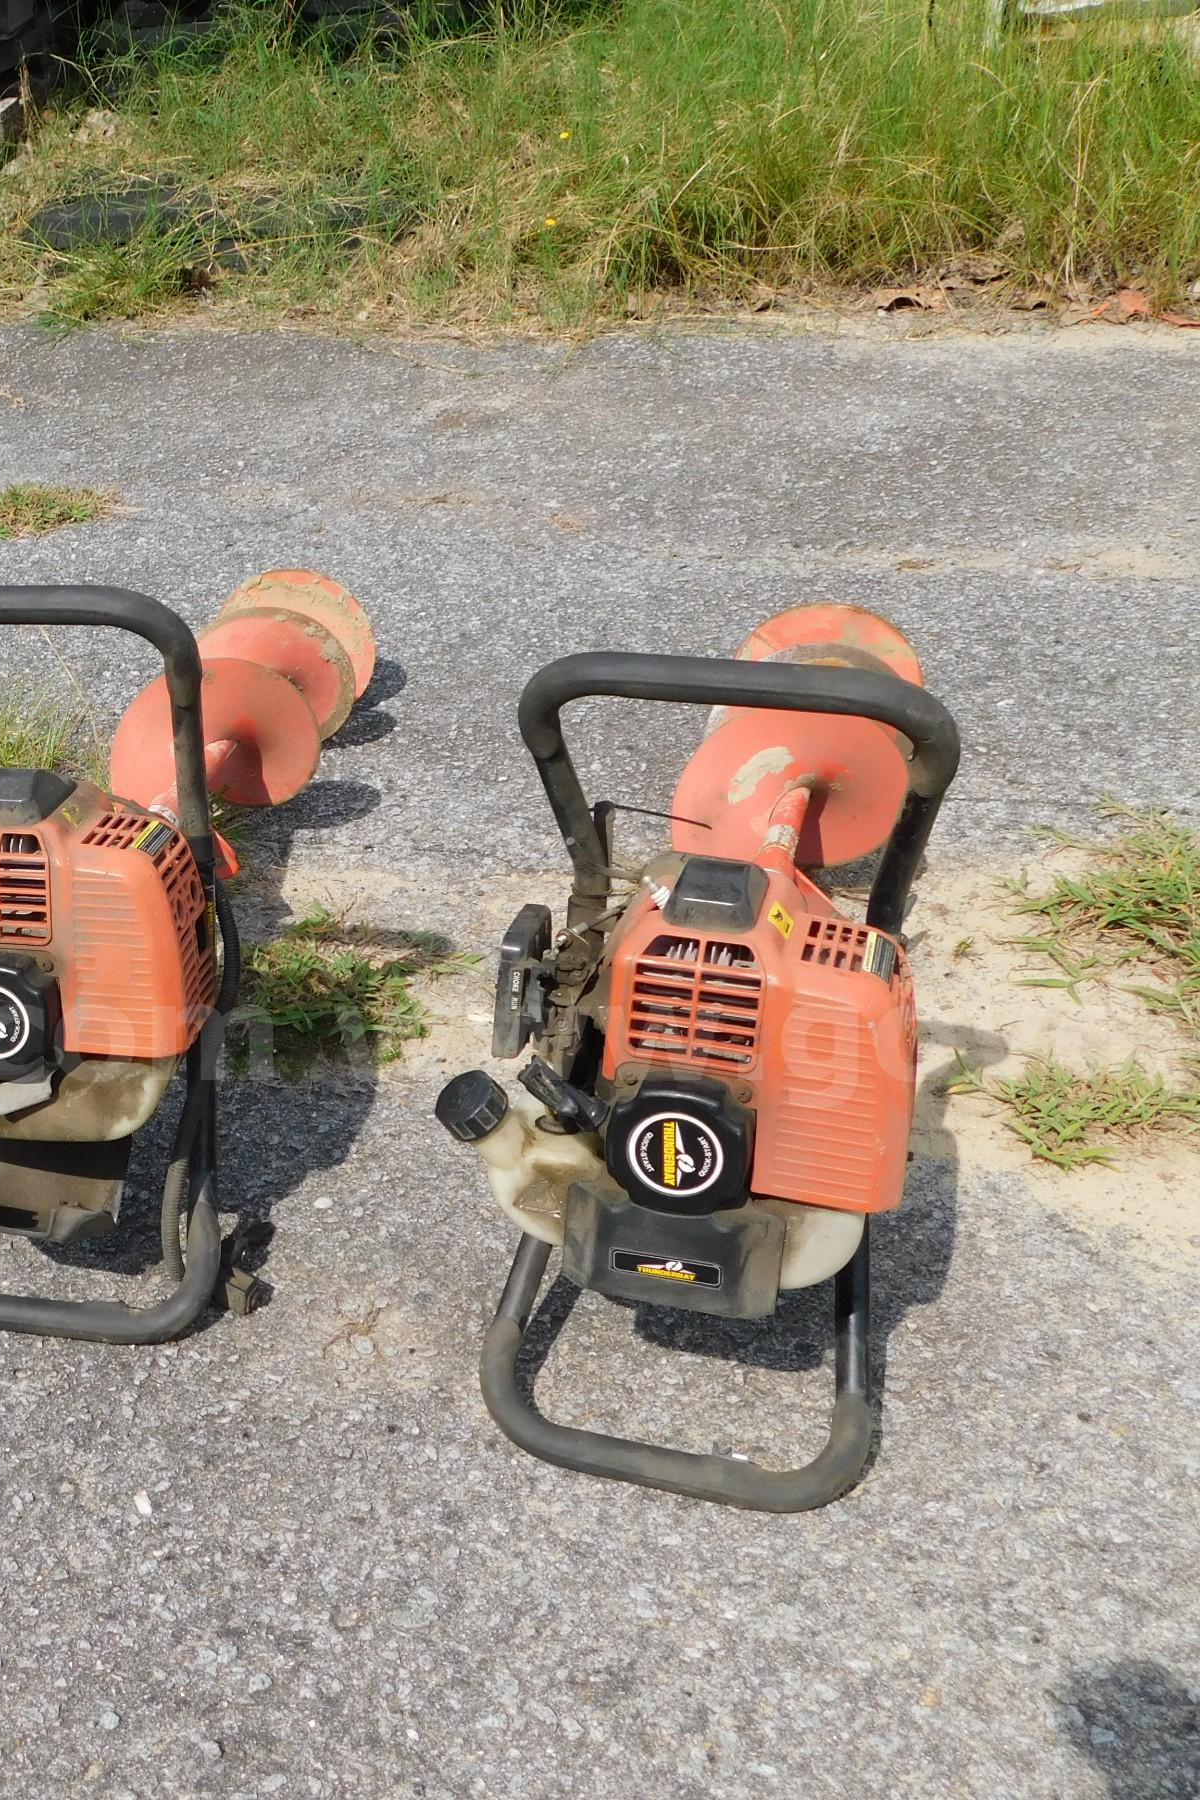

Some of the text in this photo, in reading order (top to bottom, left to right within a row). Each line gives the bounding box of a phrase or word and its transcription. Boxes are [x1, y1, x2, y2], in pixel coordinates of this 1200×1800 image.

[510, 971, 521, 1010] CHOKE RUN
[9, 1006, 21, 1043] QUICK-START
[640, 1131, 656, 1173] QUICK-START
[663, 1121, 676, 1187] THUNDERBAY
[697, 1136, 712, 1178] QUICK-START
[636, 1265, 697, 1281] THUNDERBAY
